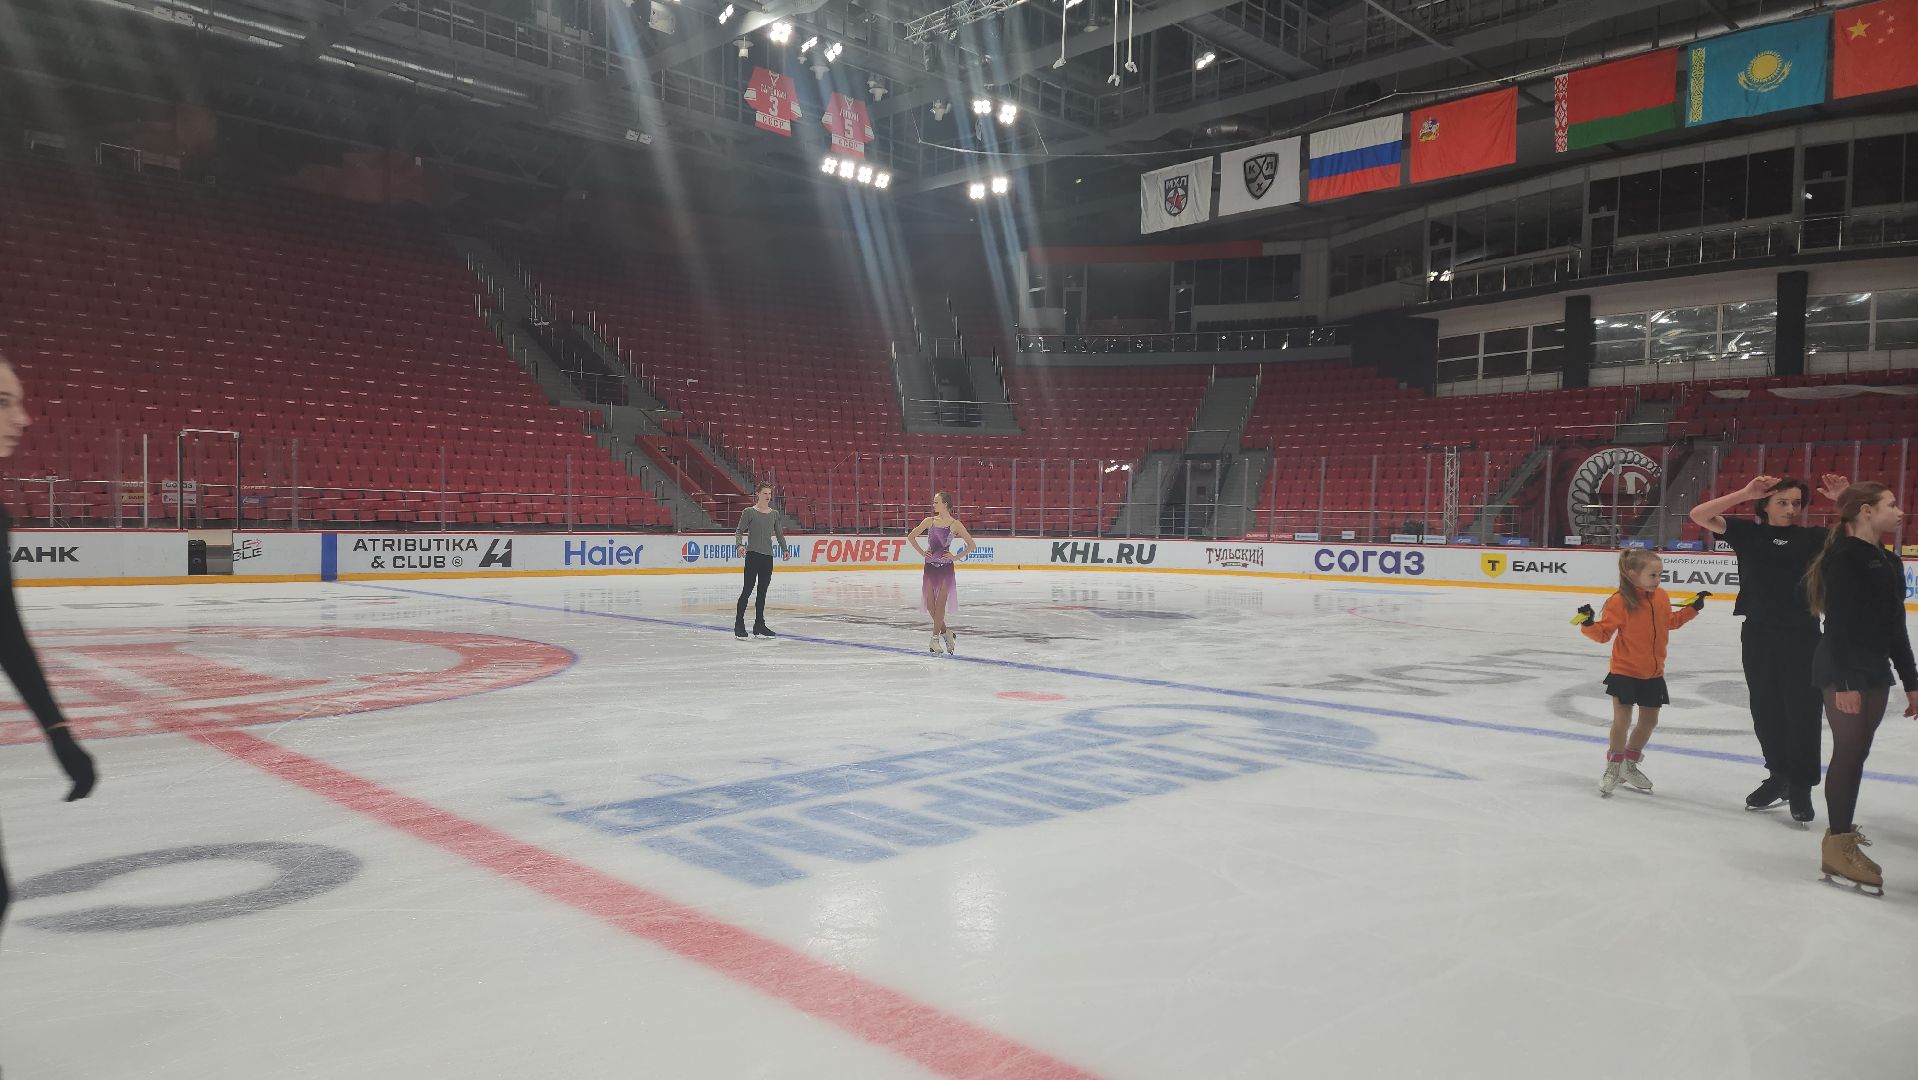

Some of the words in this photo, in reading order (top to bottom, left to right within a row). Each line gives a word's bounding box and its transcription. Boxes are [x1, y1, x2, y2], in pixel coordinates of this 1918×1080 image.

[768, 95, 779, 116] 3
[844, 118, 854, 138] 5
[1166, 177, 1187, 189] МХЛ
[353, 538, 478, 552] ATRIBUTIKA
[564, 539, 644, 566] Haier
[811, 540, 906, 562] FONBET
[1050, 541, 1157, 565] KHL.RU
[8, 546, 80, 562] АНК
[371, 556, 385, 568] &
[392, 556, 446, 568] CLUB
[1205, 547, 1264, 567] ТУЛЬСКИЙ
[1663, 558, 1729, 566] ОМОБИЛЬНЫЕ
[1513, 561, 1568, 573] БАНК
[1659, 570, 1740, 586] SLAVE
